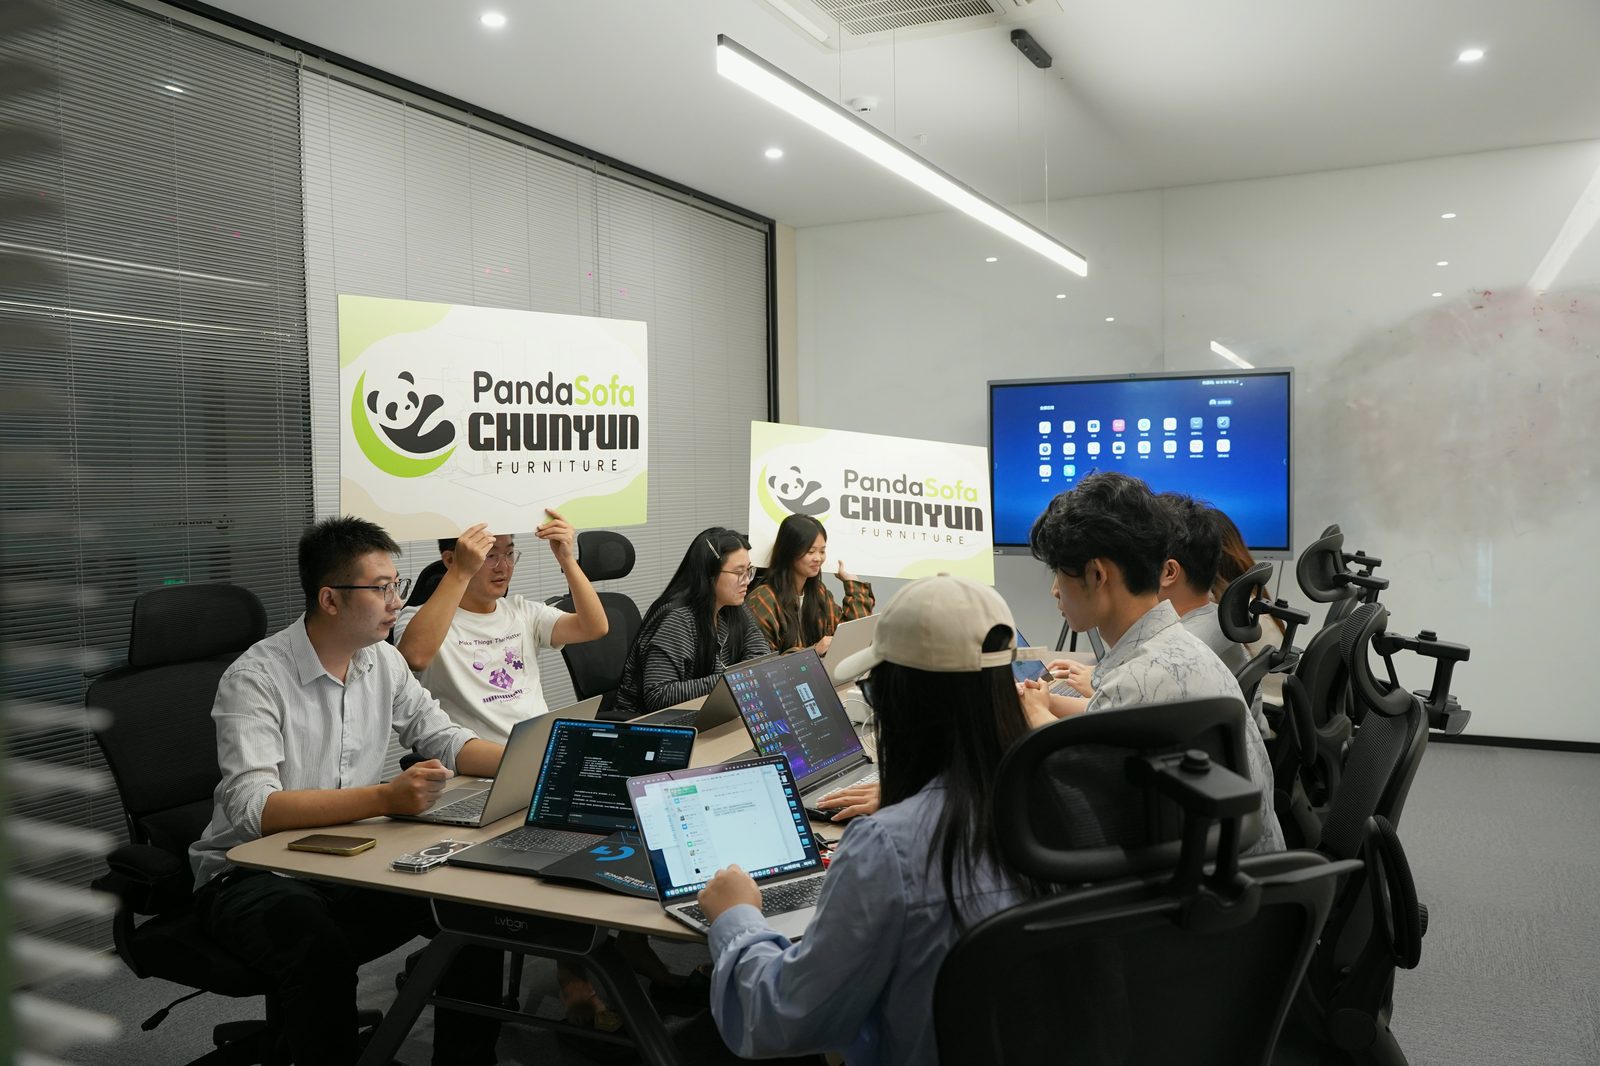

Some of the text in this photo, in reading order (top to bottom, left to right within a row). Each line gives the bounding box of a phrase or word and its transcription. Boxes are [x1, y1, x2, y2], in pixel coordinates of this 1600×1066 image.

[473, 370, 635, 407] PandaSofa
[468, 412, 639, 451] CHUNYUN
[496, 459, 618, 474] FURNITURE
[844, 469, 978, 502] PandaSofa
[839, 494, 984, 532] CHUNYUN
[861, 527, 965, 545] FURNITURE
